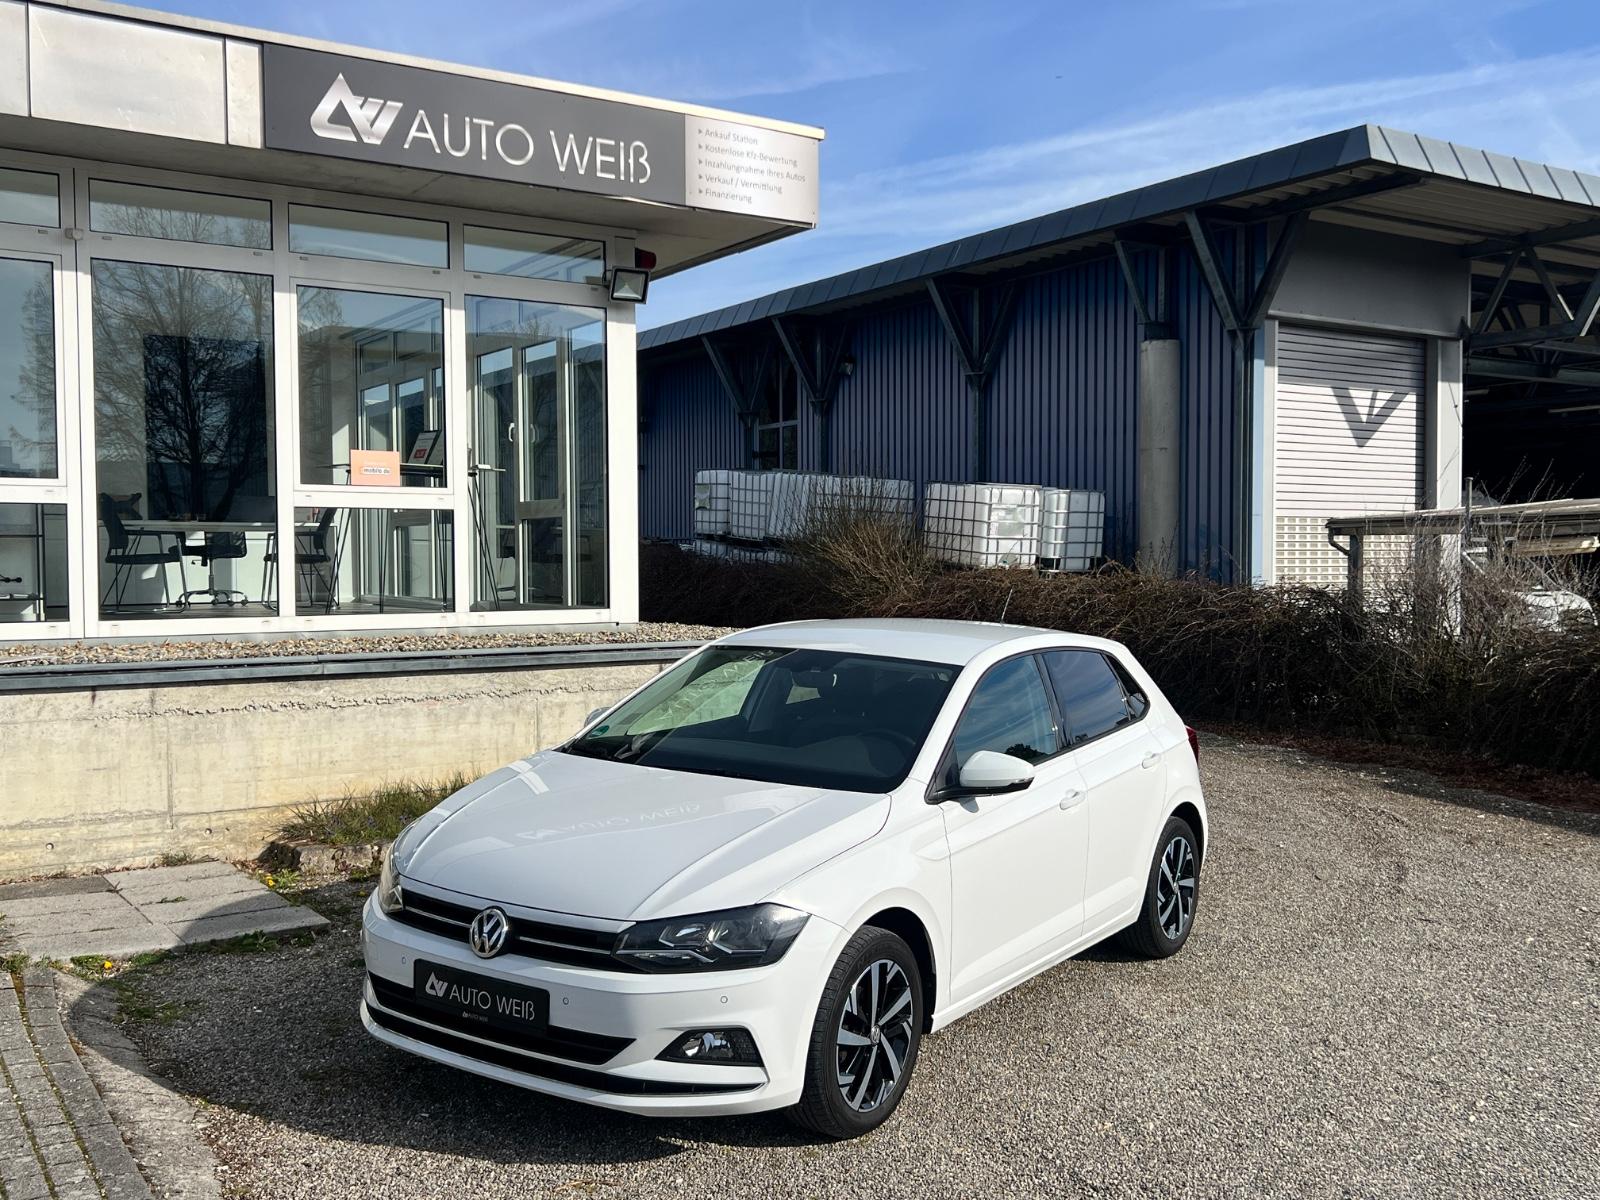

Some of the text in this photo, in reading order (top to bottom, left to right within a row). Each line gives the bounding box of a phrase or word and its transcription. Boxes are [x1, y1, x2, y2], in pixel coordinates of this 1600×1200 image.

[403, 109, 534, 166] AUTO
[550, 129, 651, 184] WEIß
[705, 129, 758, 145] Ankauf Station
[705, 144, 798, 168] Kostenlose Kfz-Bewertung
[705, 174, 733, 186] Verkauf
[740, 180, 783, 194] Vermittlung
[766, 168, 784, 180] Ihres
[786, 172, 806, 183] Autos
[705, 189, 752, 204] Finanzierung
[449, 984, 492, 1009] AUTO
[496, 994, 536, 1021] WEIß
